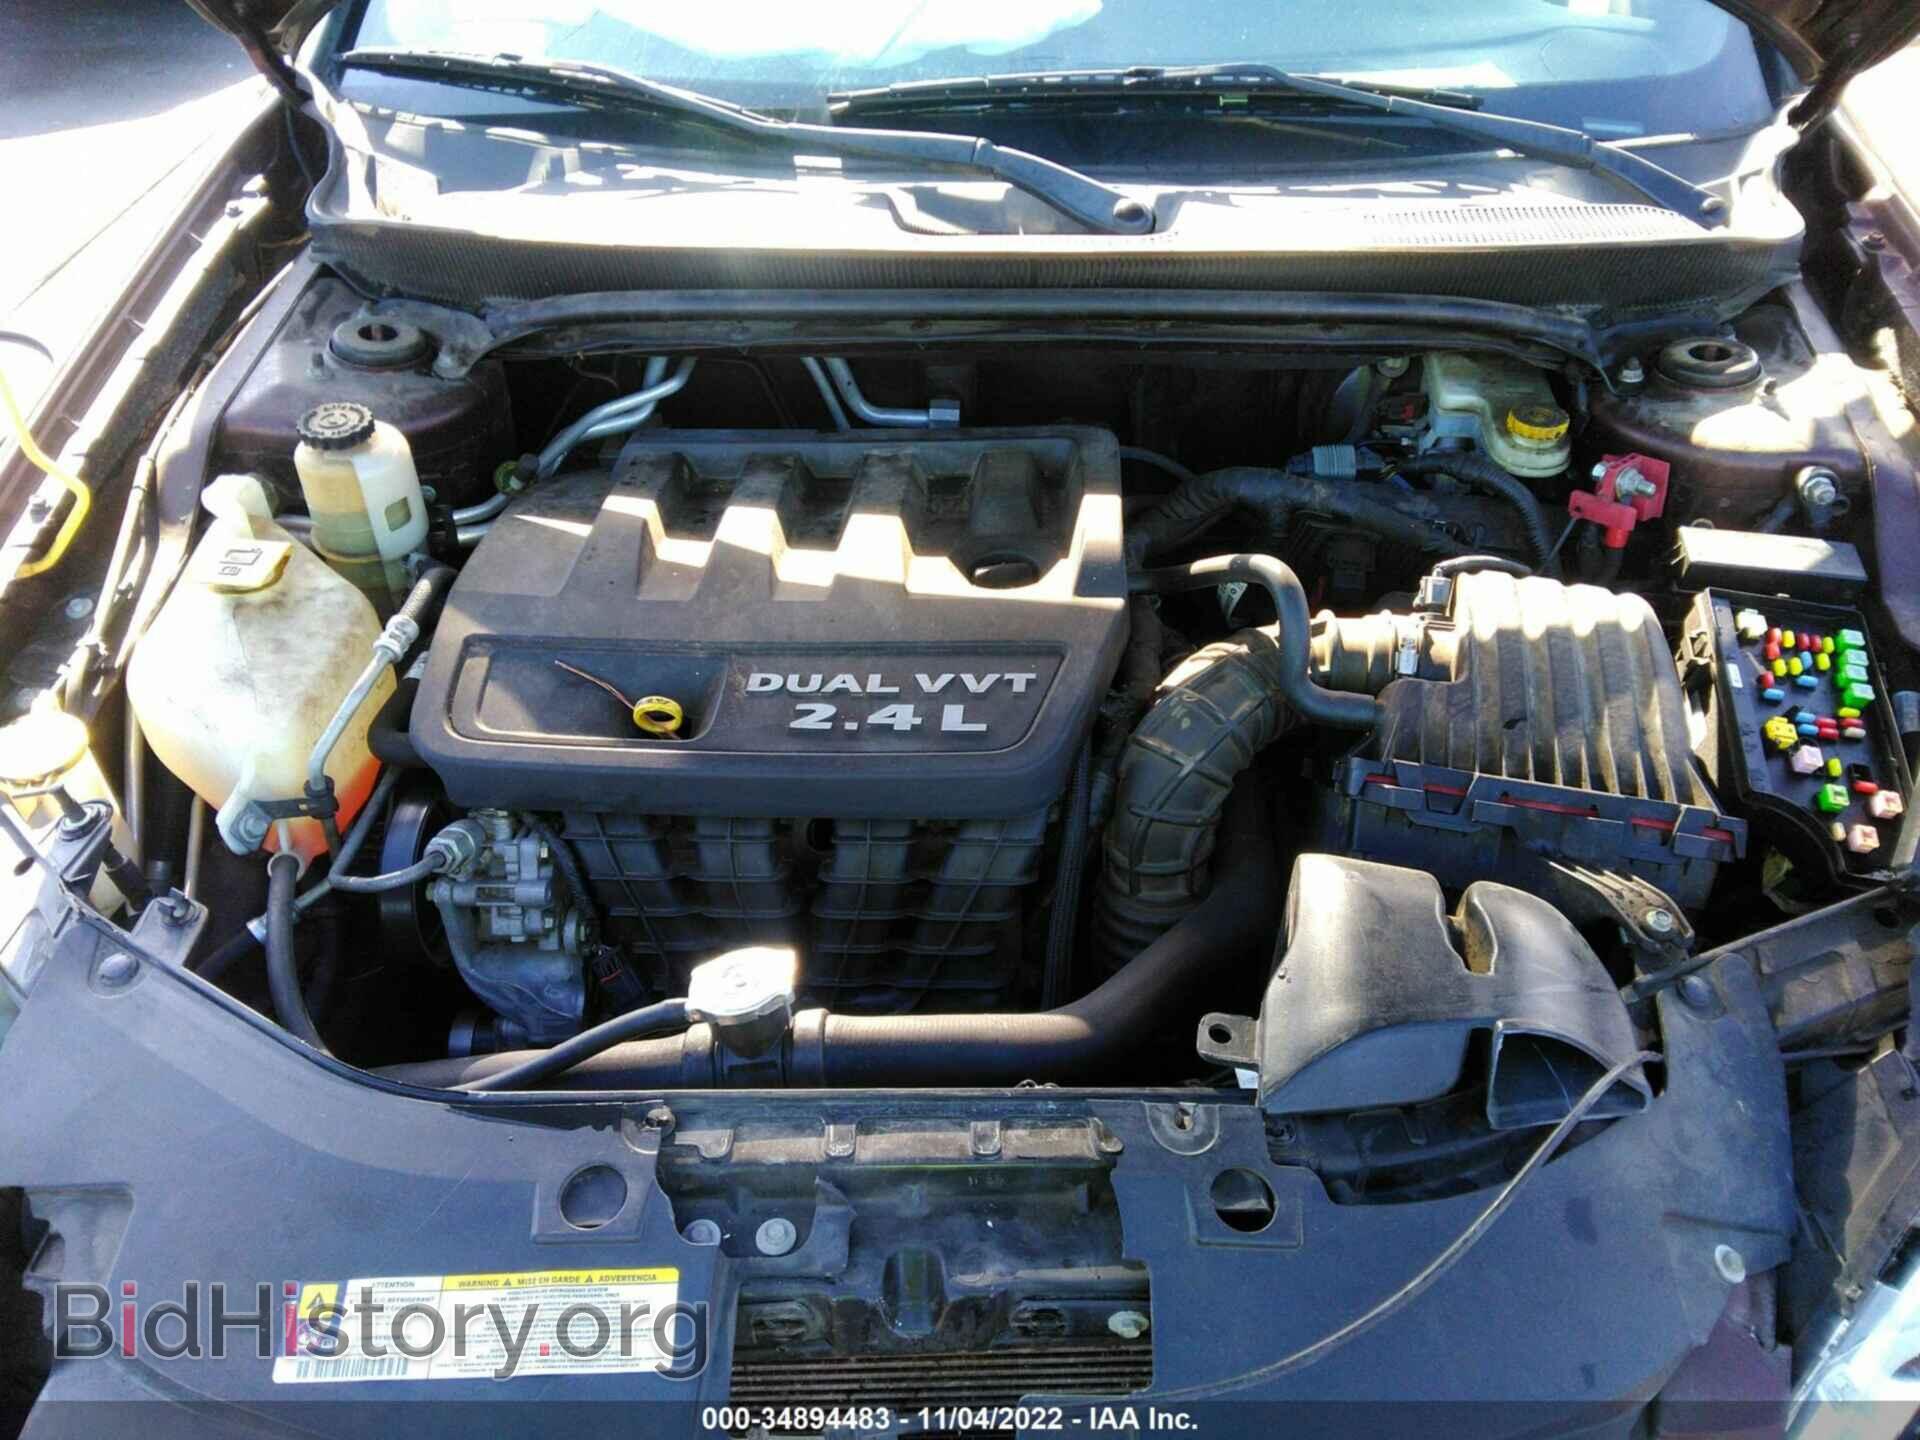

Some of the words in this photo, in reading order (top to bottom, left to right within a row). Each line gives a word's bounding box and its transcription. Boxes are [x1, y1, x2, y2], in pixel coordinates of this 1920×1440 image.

[746, 673, 901, 693] DUAL
[917, 673, 1037, 693] VVT
[372, 1281, 415, 1289] ATTENTION
[457, 1279, 499, 1289] WARNING
[517, 1277, 537, 1287] MISE
[551, 1275, 581, 1285] GARDE
[598, 1273, 657, 1283] ADVERTENCIA
